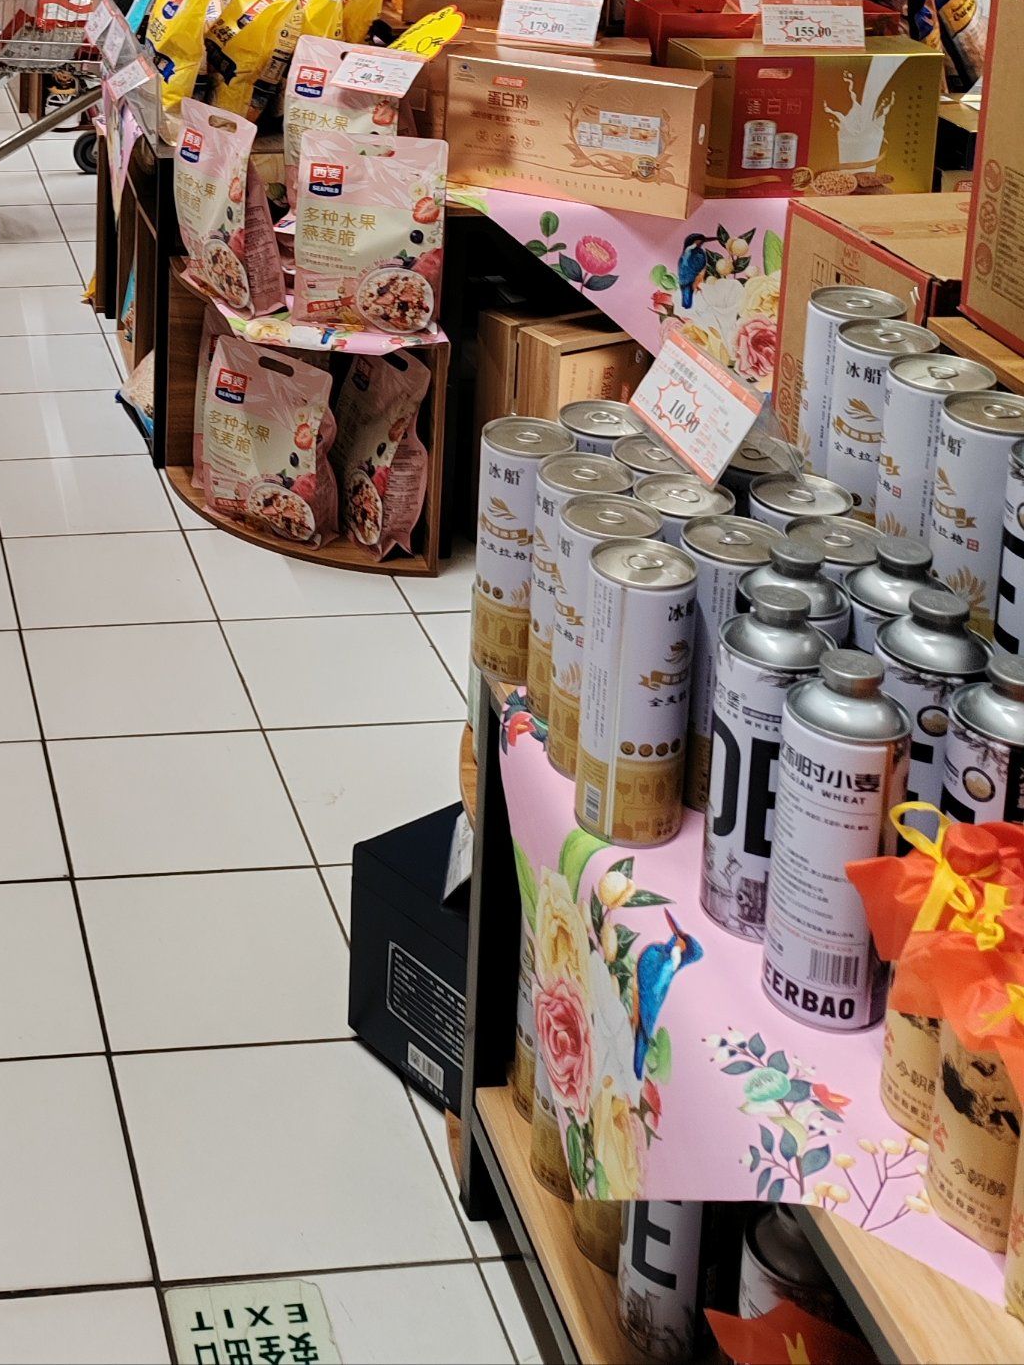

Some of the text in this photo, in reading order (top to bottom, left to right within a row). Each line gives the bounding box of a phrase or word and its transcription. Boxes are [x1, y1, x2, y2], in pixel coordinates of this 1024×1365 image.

[529, 18, 565, 34] 179.00
[794, 25, 833, 38] 155.00
[298, 68, 324, 82] 西麦
[487, 90, 529, 109] 蛋白粉
[746, 97, 803, 116] 蛋白粉
[289, 106, 350, 132] 多种水果
[177, 170, 217, 199] 多种水果
[313, 165, 341, 179] 西麦
[303, 206, 376, 231] 多种水果
[302, 224, 357, 247] 燕麦脆
[219, 372, 246, 387] 西麦
[846, 360, 881, 385] 冰船
[209, 409, 270, 444] 多种水果
[668, 399, 700, 434] 10.90
[209, 425, 252, 455] 燕麦脆
[488, 461, 521, 486] 冰船
[480, 536, 528, 562] 全麦拉格
[821, 791, 867, 806] WHEAT
[191, 1303, 308, 1331] EXIT
